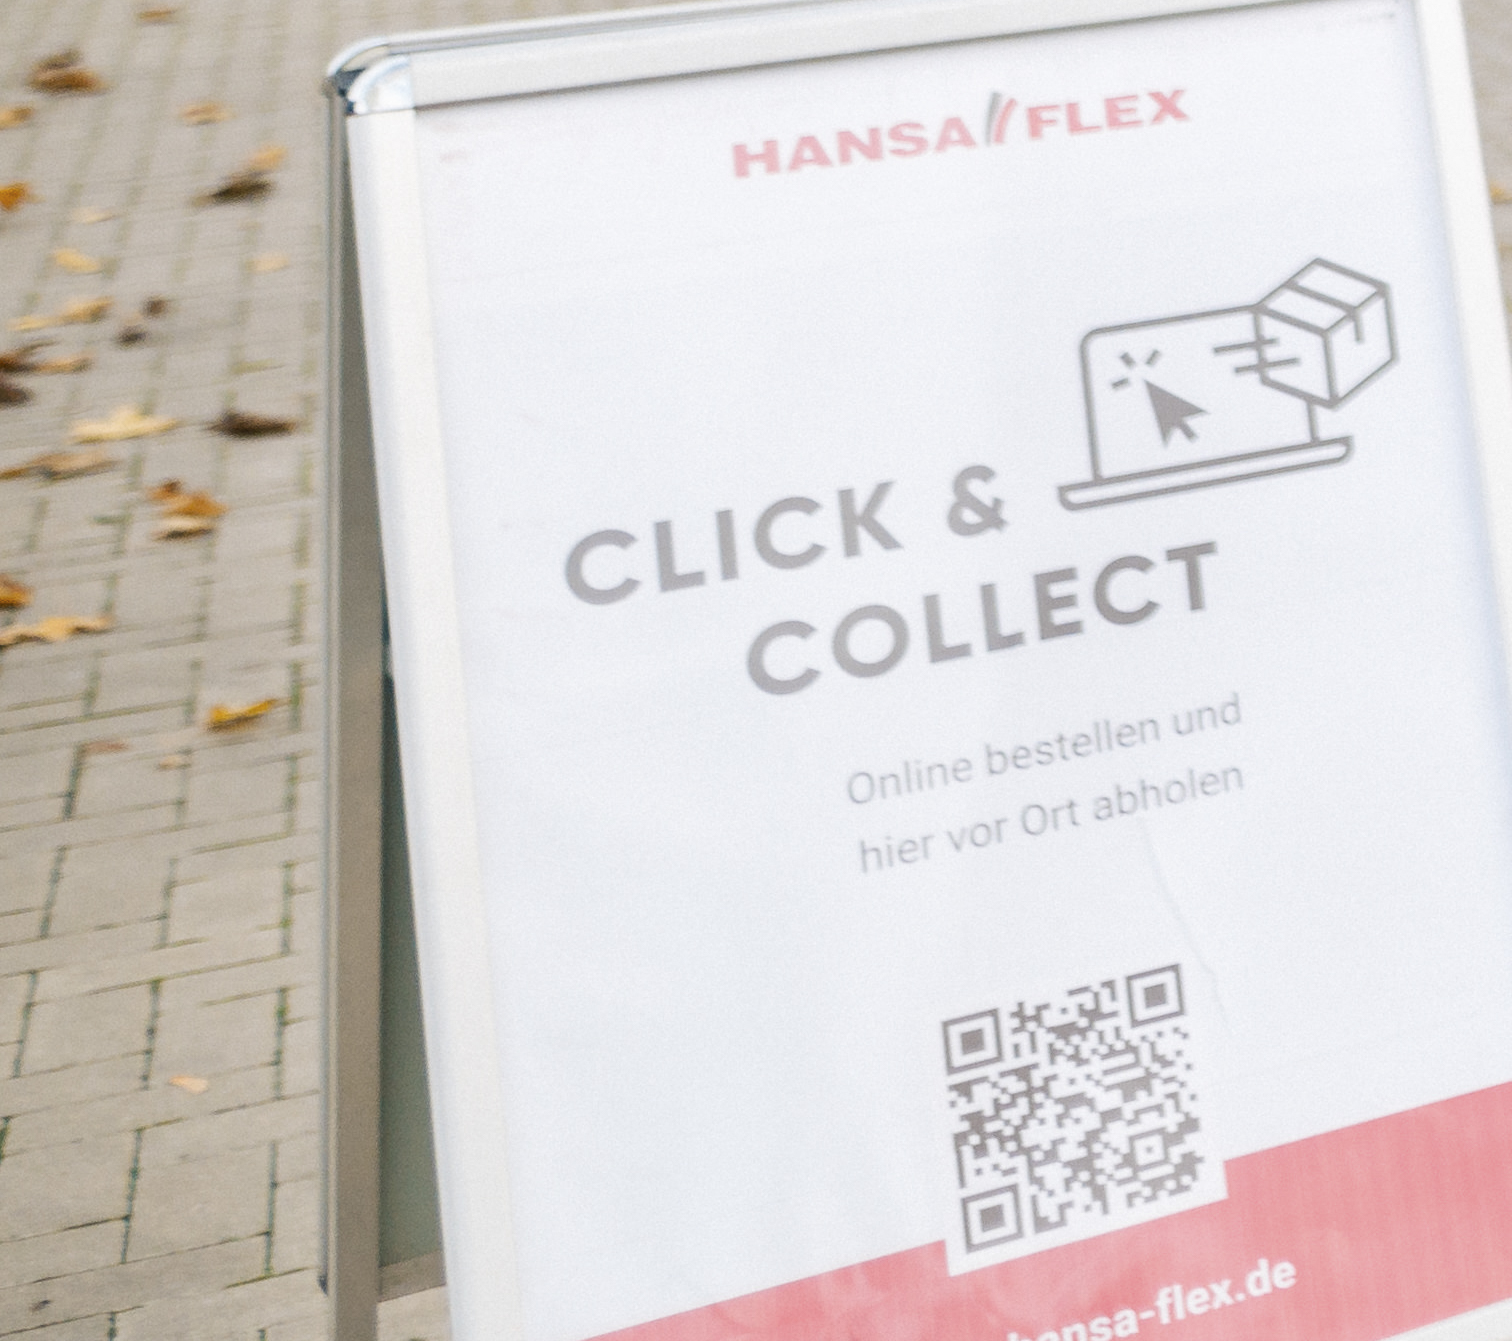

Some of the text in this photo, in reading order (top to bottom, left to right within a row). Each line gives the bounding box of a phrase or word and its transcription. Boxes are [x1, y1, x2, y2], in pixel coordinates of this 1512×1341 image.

[565, 465, 1008, 605] CLICK &
[747, 541, 1217, 695] COLLECT
[847, 692, 1241, 804] Online bestellen und
[859, 766, 1244, 873] hier vor Ort abholen
